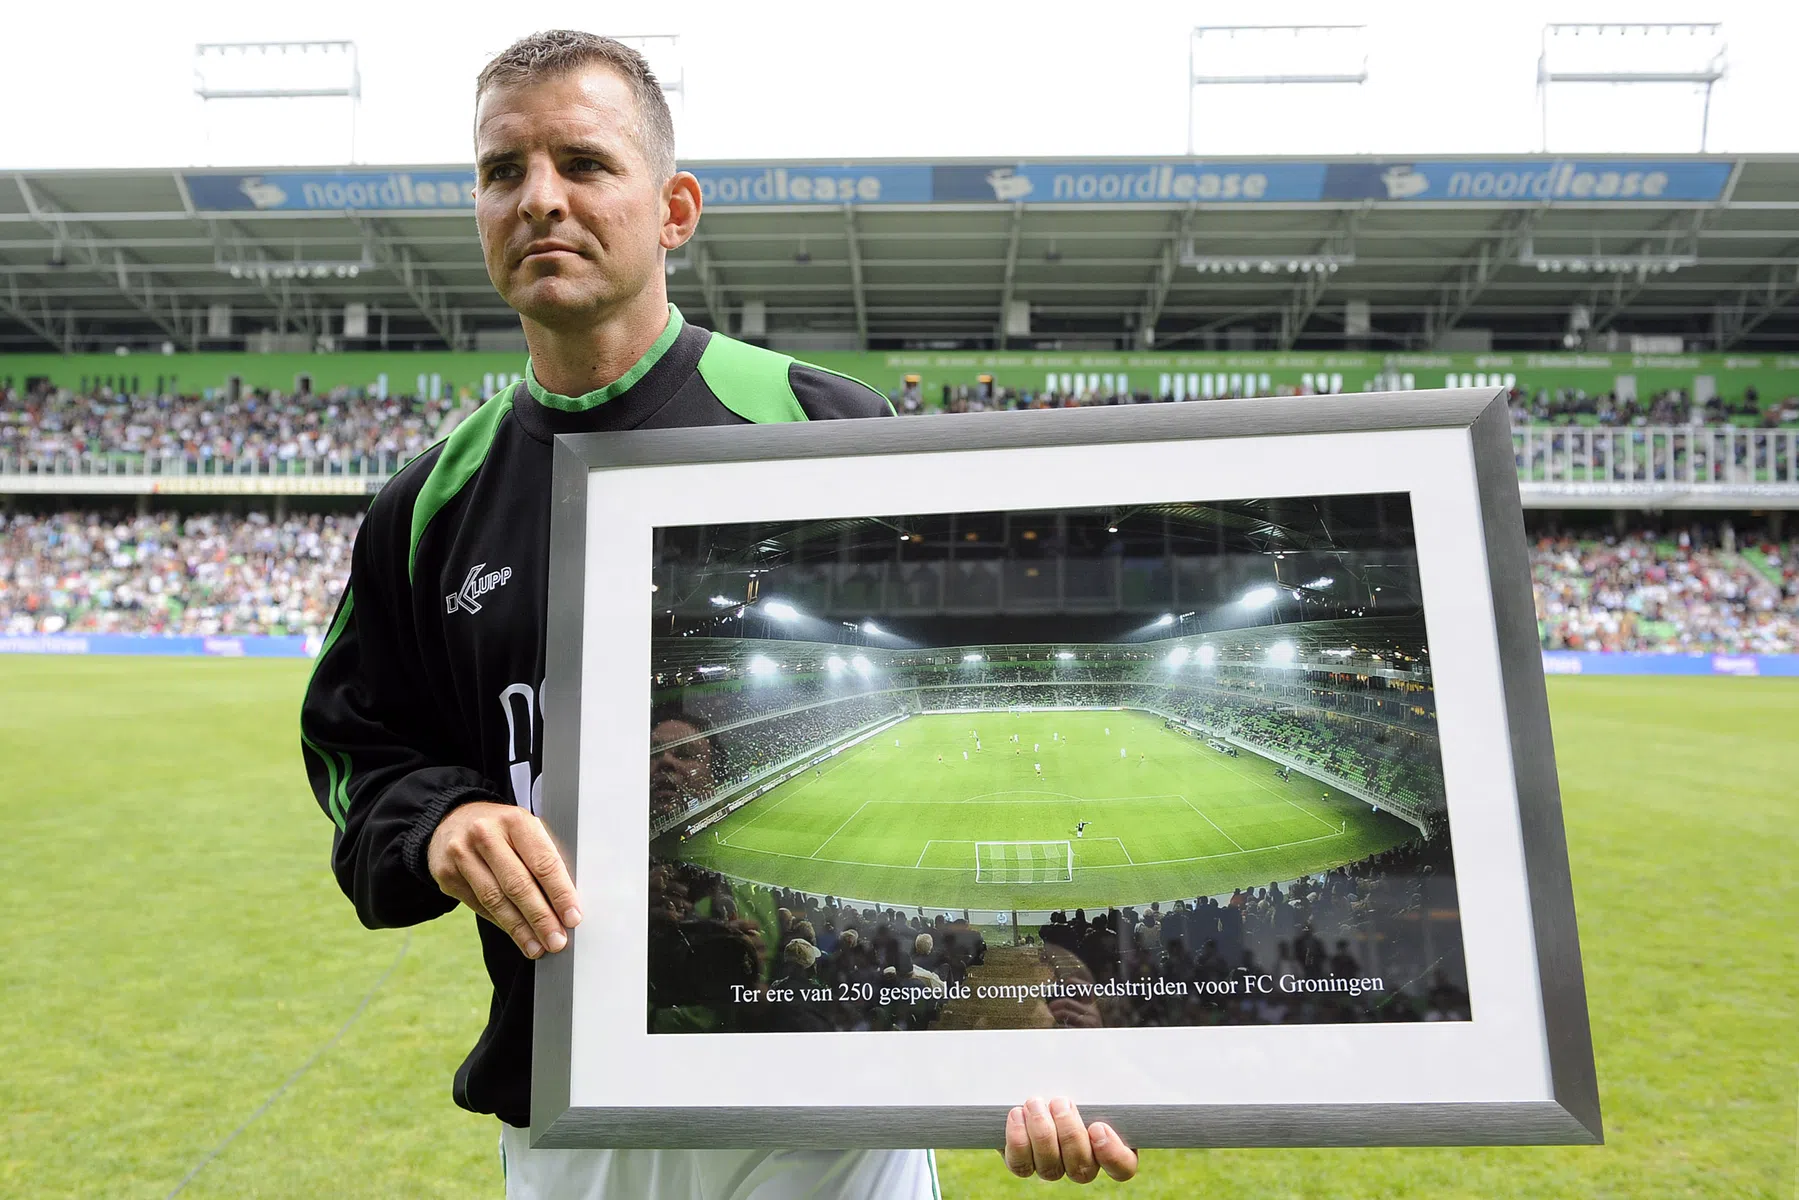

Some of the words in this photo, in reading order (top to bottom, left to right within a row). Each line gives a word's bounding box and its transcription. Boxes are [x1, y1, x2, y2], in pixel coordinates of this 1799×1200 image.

[701, 168, 881, 202] oordlease
[1053, 165, 1268, 199] noordlease
[1448, 162, 1669, 198] noordlease
[730, 984, 760, 1003] Ter
[766, 986, 794, 1002] ere
[799, 986, 833, 1001] van
[838, 982, 873, 1001] 250
[879, 980, 971, 1005] gespeelde
[976, 976, 1188, 1003] competitiewedstrijden
[1193, 980, 1239, 995] voor
[1244, 975, 1274, 994] FC
[1279, 972, 1385, 996] Groningen
